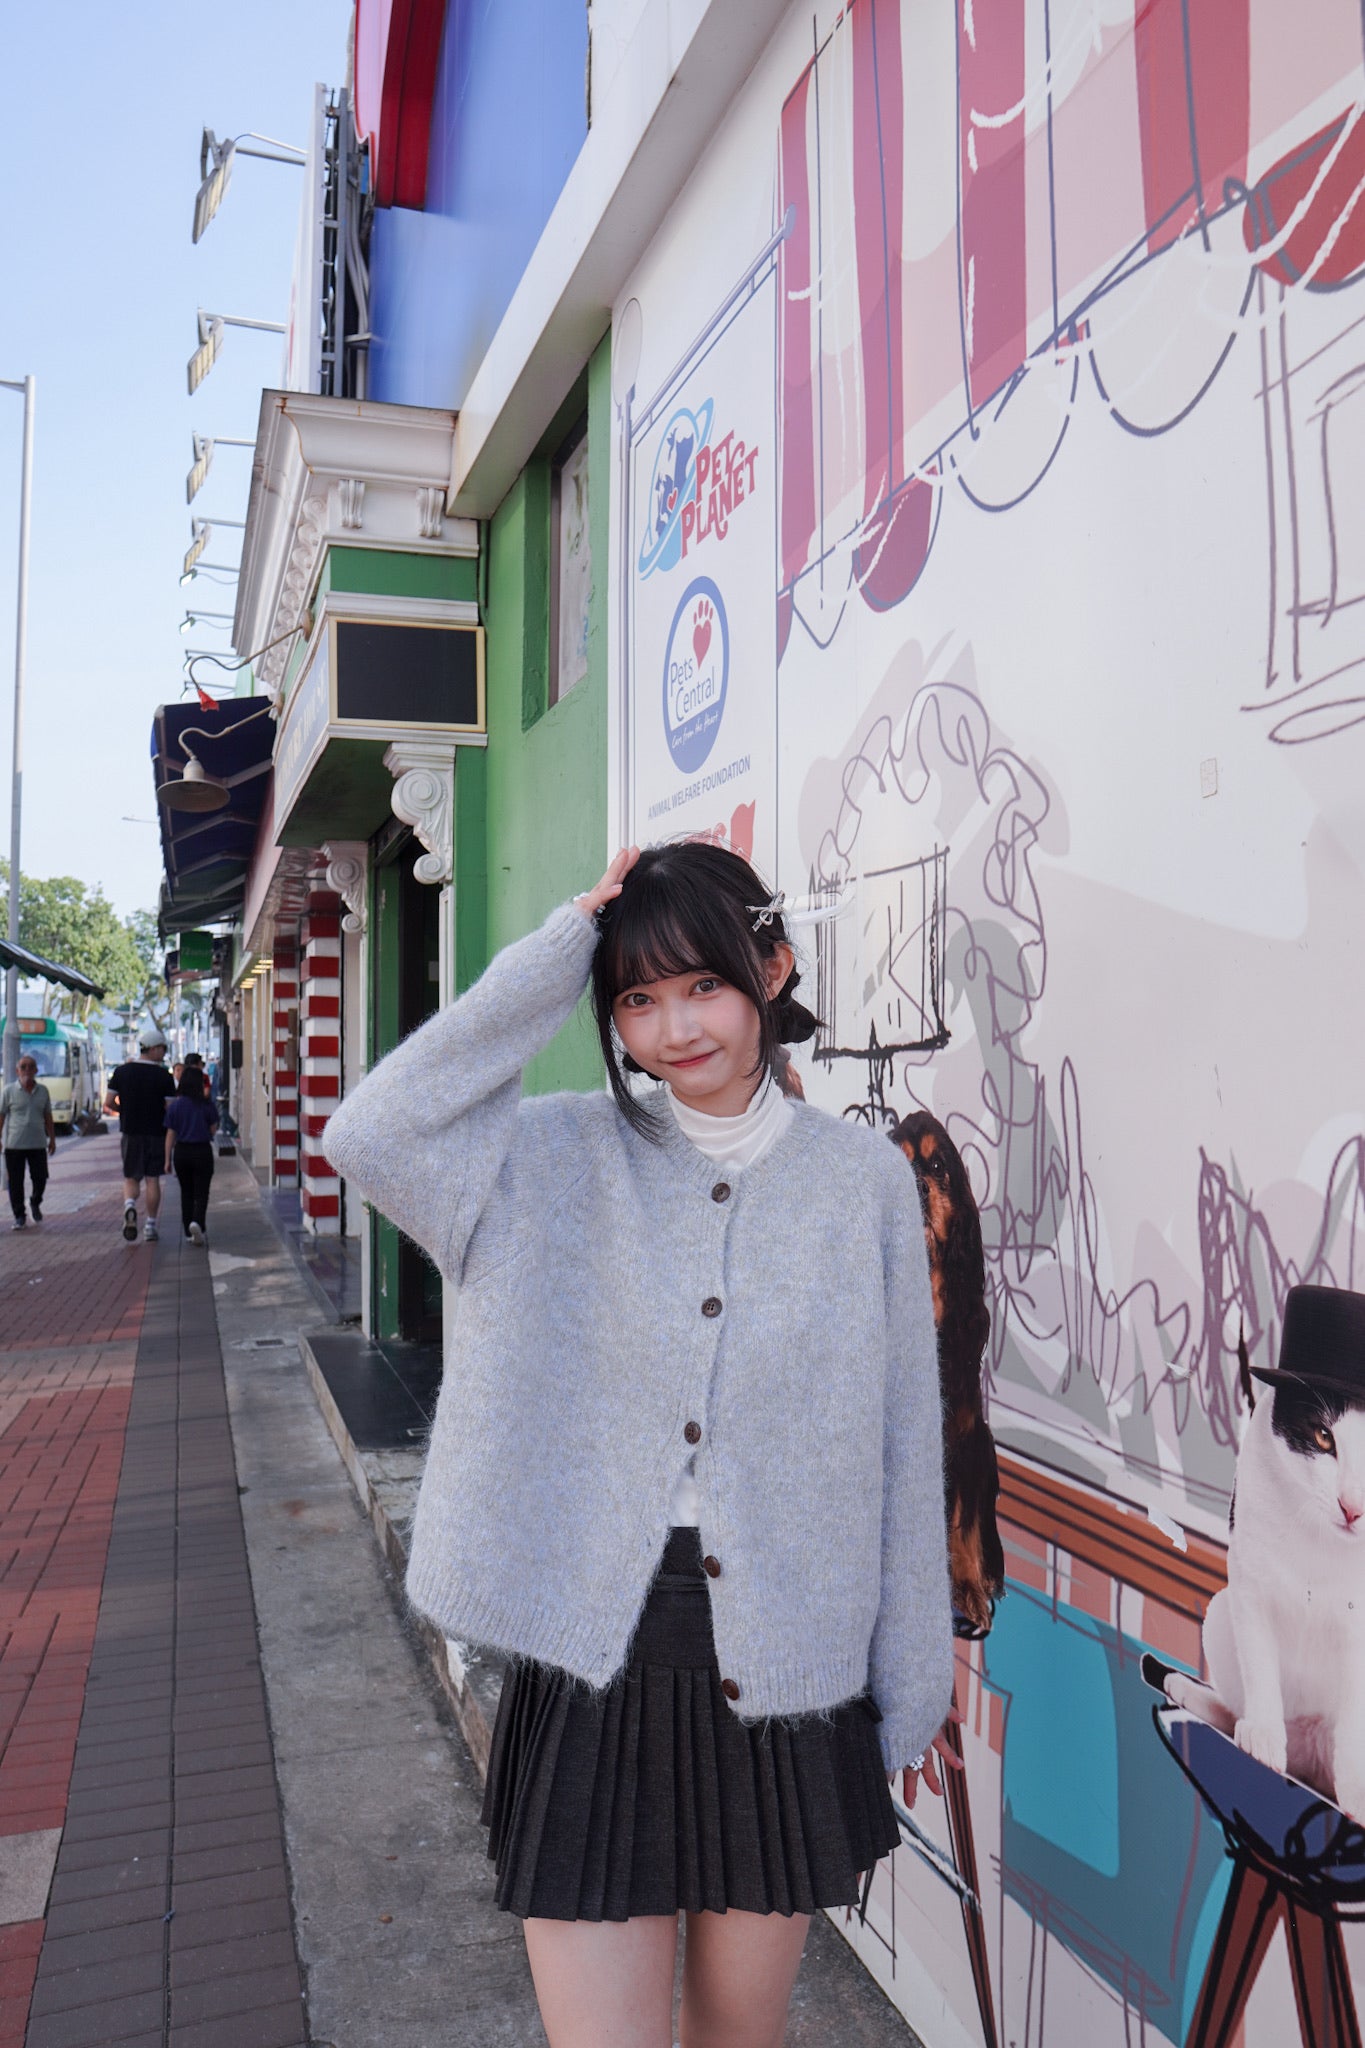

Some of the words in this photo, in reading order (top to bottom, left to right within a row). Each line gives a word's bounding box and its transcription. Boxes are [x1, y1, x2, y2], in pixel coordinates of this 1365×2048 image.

[695, 429, 746, 506] PETS
[681, 446, 759, 560] PLANET
[671, 658, 693, 697] Pets
[676, 665, 715, 722] Central
[647, 796, 671, 821] ANIMAL
[671, 780, 701, 809] WELFARE
[702, 754, 751, 795] FOUNDATION
